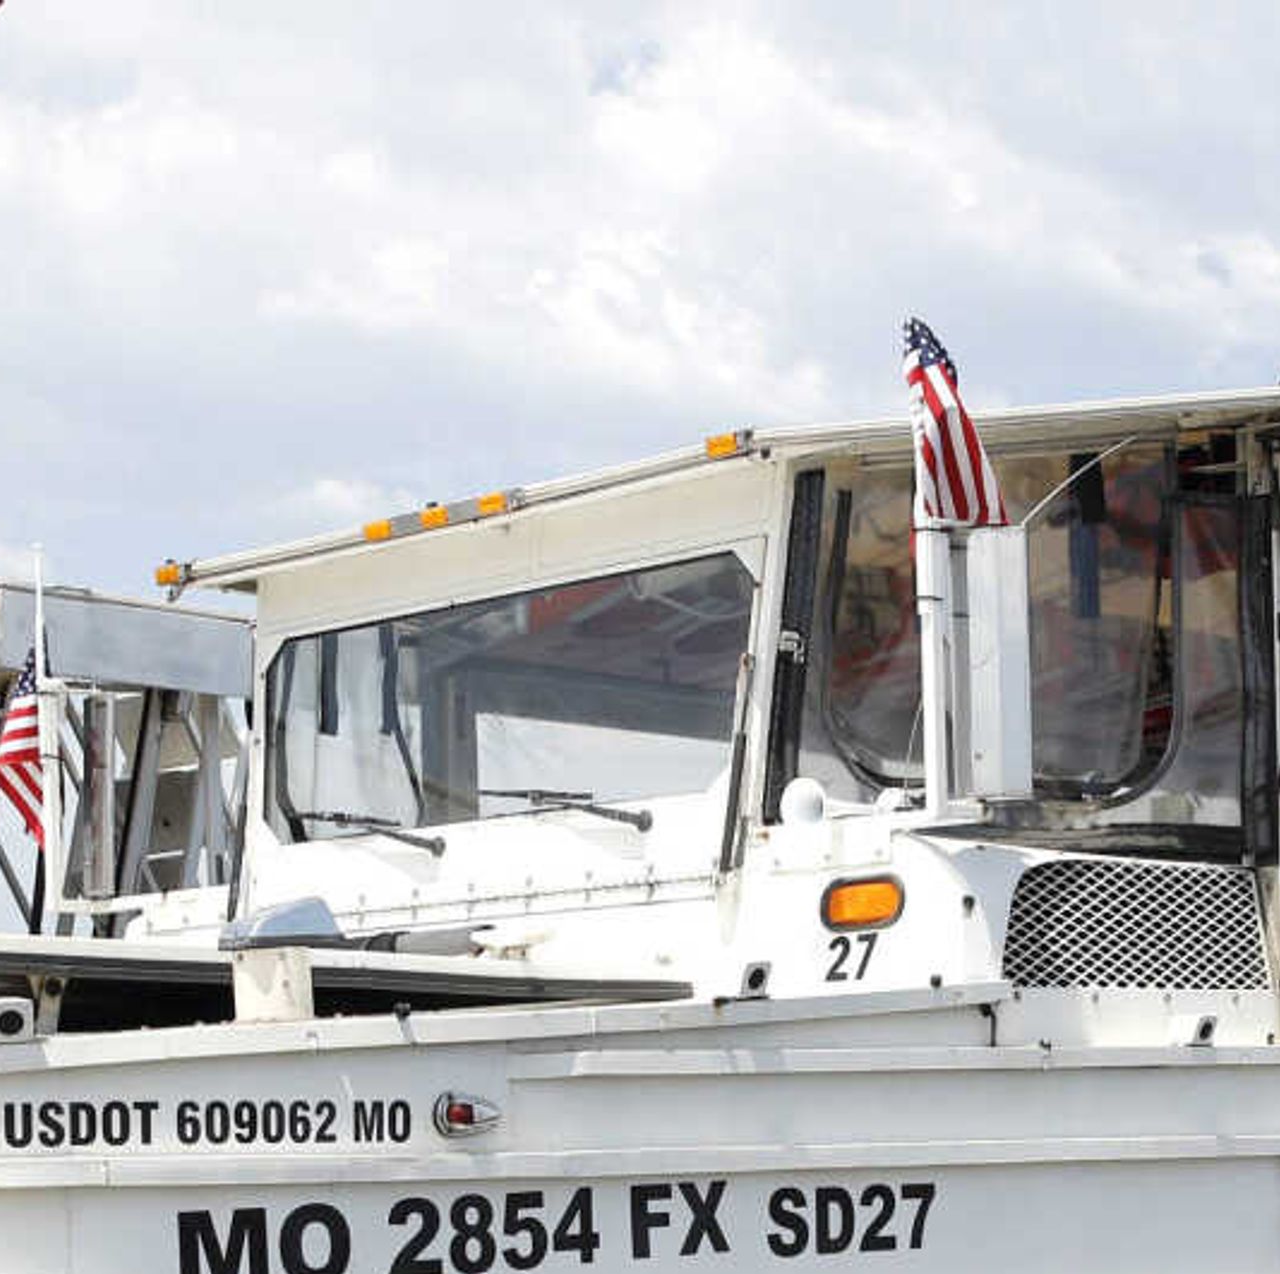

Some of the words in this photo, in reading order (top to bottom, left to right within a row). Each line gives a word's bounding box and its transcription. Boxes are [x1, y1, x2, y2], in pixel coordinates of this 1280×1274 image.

[825, 932, 878, 982] 27
[3, 1100, 160, 1148] USDOT
[176, 1099, 336, 1145] 609062
[353, 1099, 412, 1143] MO
[629, 1180, 732, 1260] FX
[766, 1182, 937, 1258] SD27
